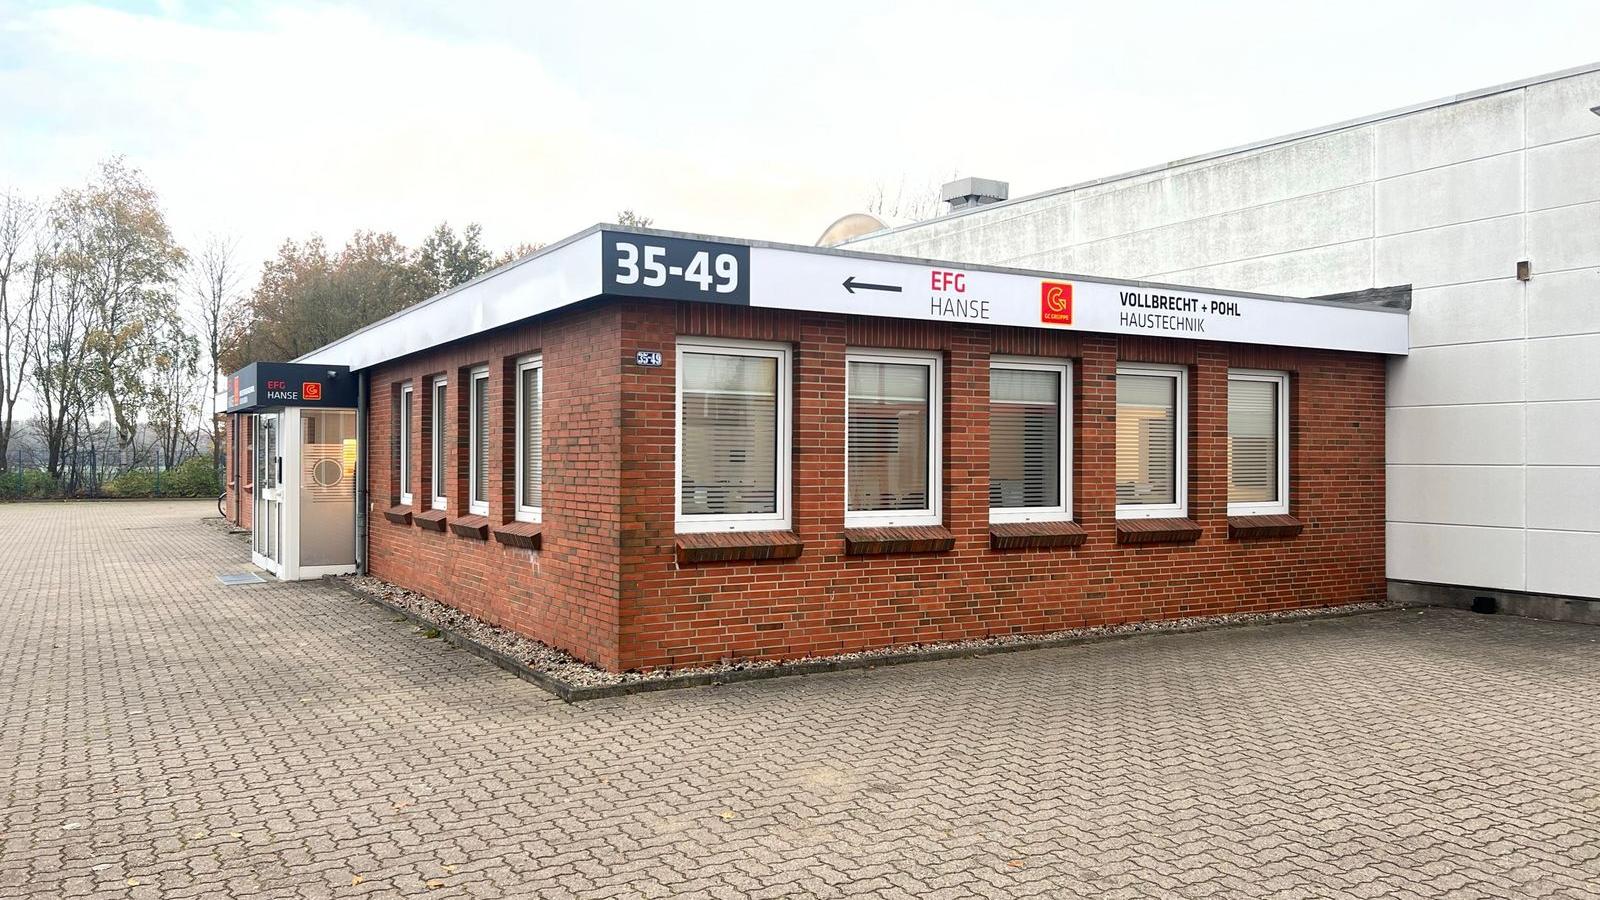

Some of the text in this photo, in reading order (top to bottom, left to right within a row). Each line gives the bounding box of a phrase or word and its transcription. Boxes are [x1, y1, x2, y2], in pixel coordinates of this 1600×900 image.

[615, 242, 739, 293] 35-49
[931, 271, 966, 292] EFG
[931, 296, 990, 319] HANSE
[1119, 291, 1241, 316] VOLLBRECHT + POHL
[1120, 311, 1205, 332] HAUSTECHNIK
[637, 352, 661, 365] 35-49
[267, 381, 285, 389] EFG
[267, 391, 298, 400] HANSE
